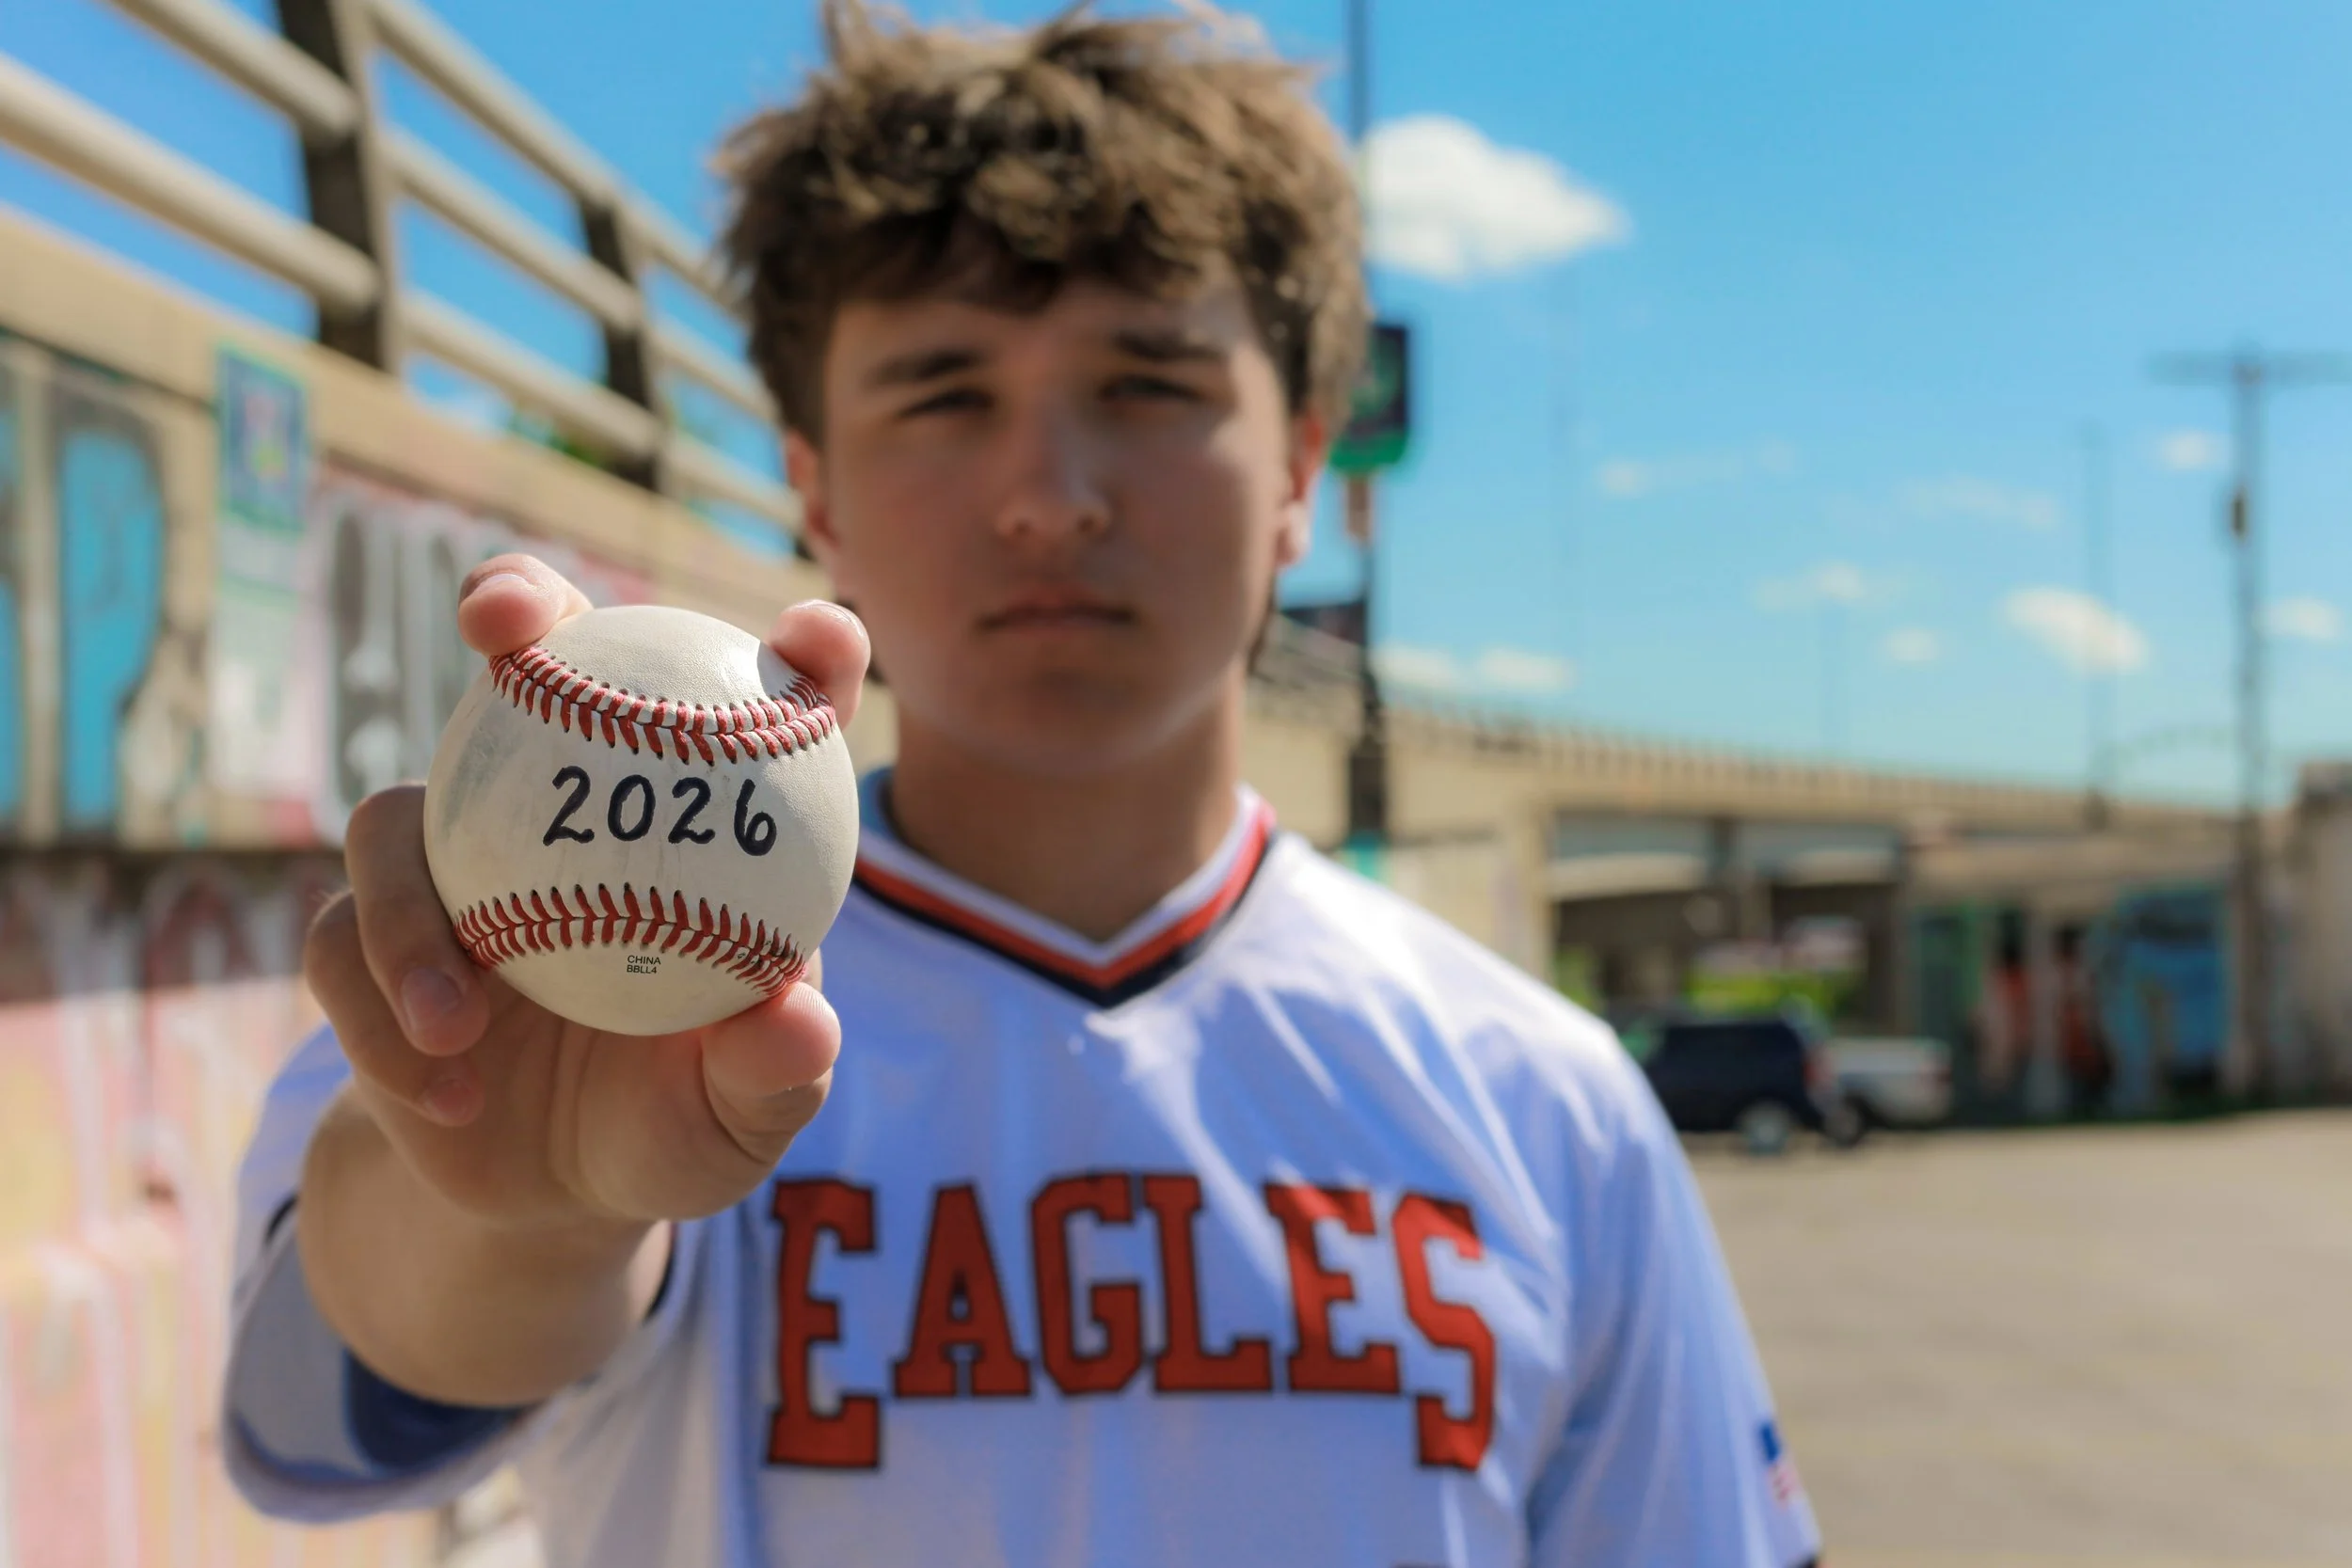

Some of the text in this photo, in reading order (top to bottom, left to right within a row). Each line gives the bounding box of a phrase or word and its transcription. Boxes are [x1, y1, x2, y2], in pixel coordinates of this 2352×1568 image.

[543, 766, 777, 856] 2026
[627, 955, 661, 965] CHINA
[627, 964, 658, 974] BBLL4
[765, 1170, 1497, 1471] EAGLES
